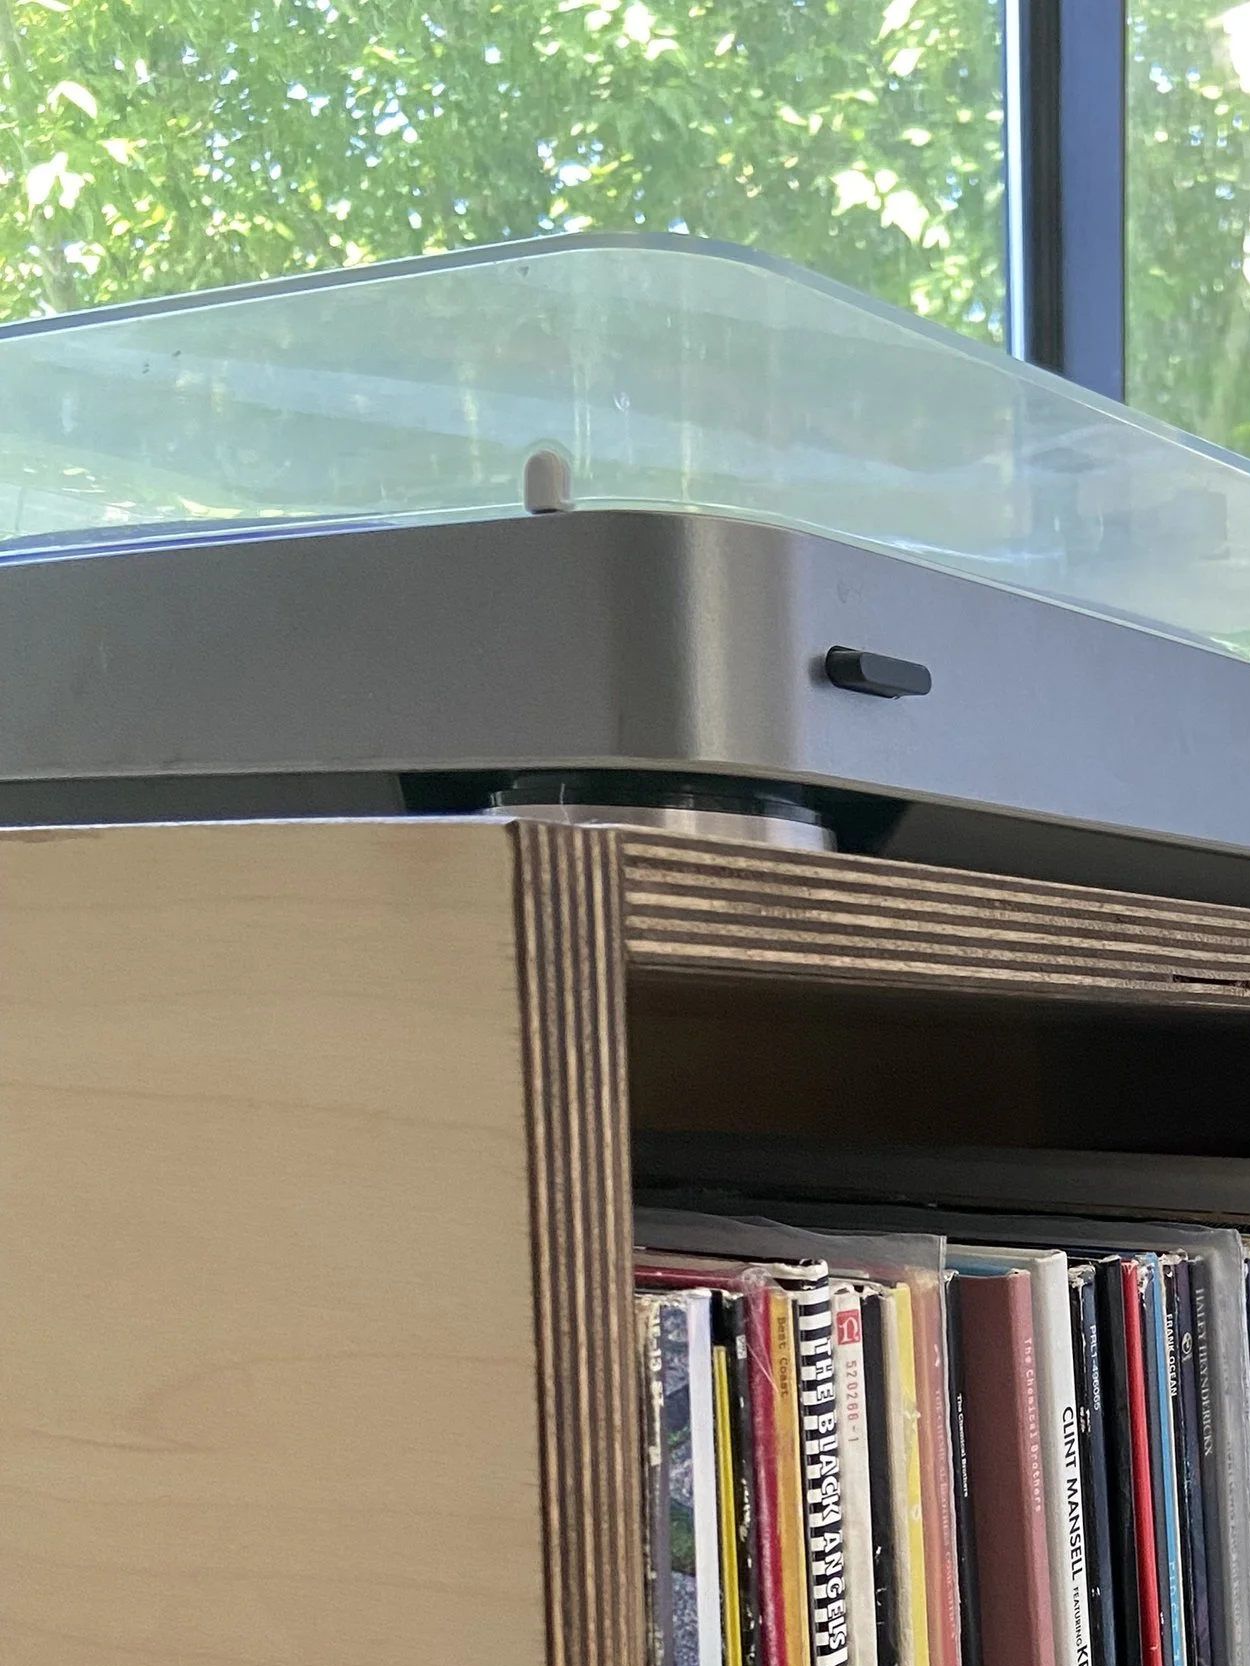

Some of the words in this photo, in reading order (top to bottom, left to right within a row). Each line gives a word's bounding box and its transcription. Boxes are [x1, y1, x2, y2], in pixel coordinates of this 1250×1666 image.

[777, 1316, 787, 1350] Best
[1166, 1313, 1176, 1355] FRANK
[1195, 1288, 1207, 1342] HALEY
[778, 1357, 789, 1399] Coast
[814, 1337, 835, 1403] THE
[1024, 1337, 1032, 1364] The
[1090, 1325, 1101, 1411] PRL1-496065
[1169, 1356, 1178, 1397] OCEAN
[1026, 1369, 1039, 1439] Chemical
[1198, 1345, 1213, 1458] HEYNDERICKX
[957, 1413, 967, 1457] Chemical
[1063, 1407, 1076, 1468] CLINT
[817, 1411, 842, 1521] BLACK
[961, 1458, 969, 1498] Brothers
[1030, 1444, 1042, 1512] Brothers
[1066, 1478, 1083, 1580] MANSELL
[822, 1529, 847, 1651] ANGELS
[1072, 1586, 1082, 1646] FEATURING
